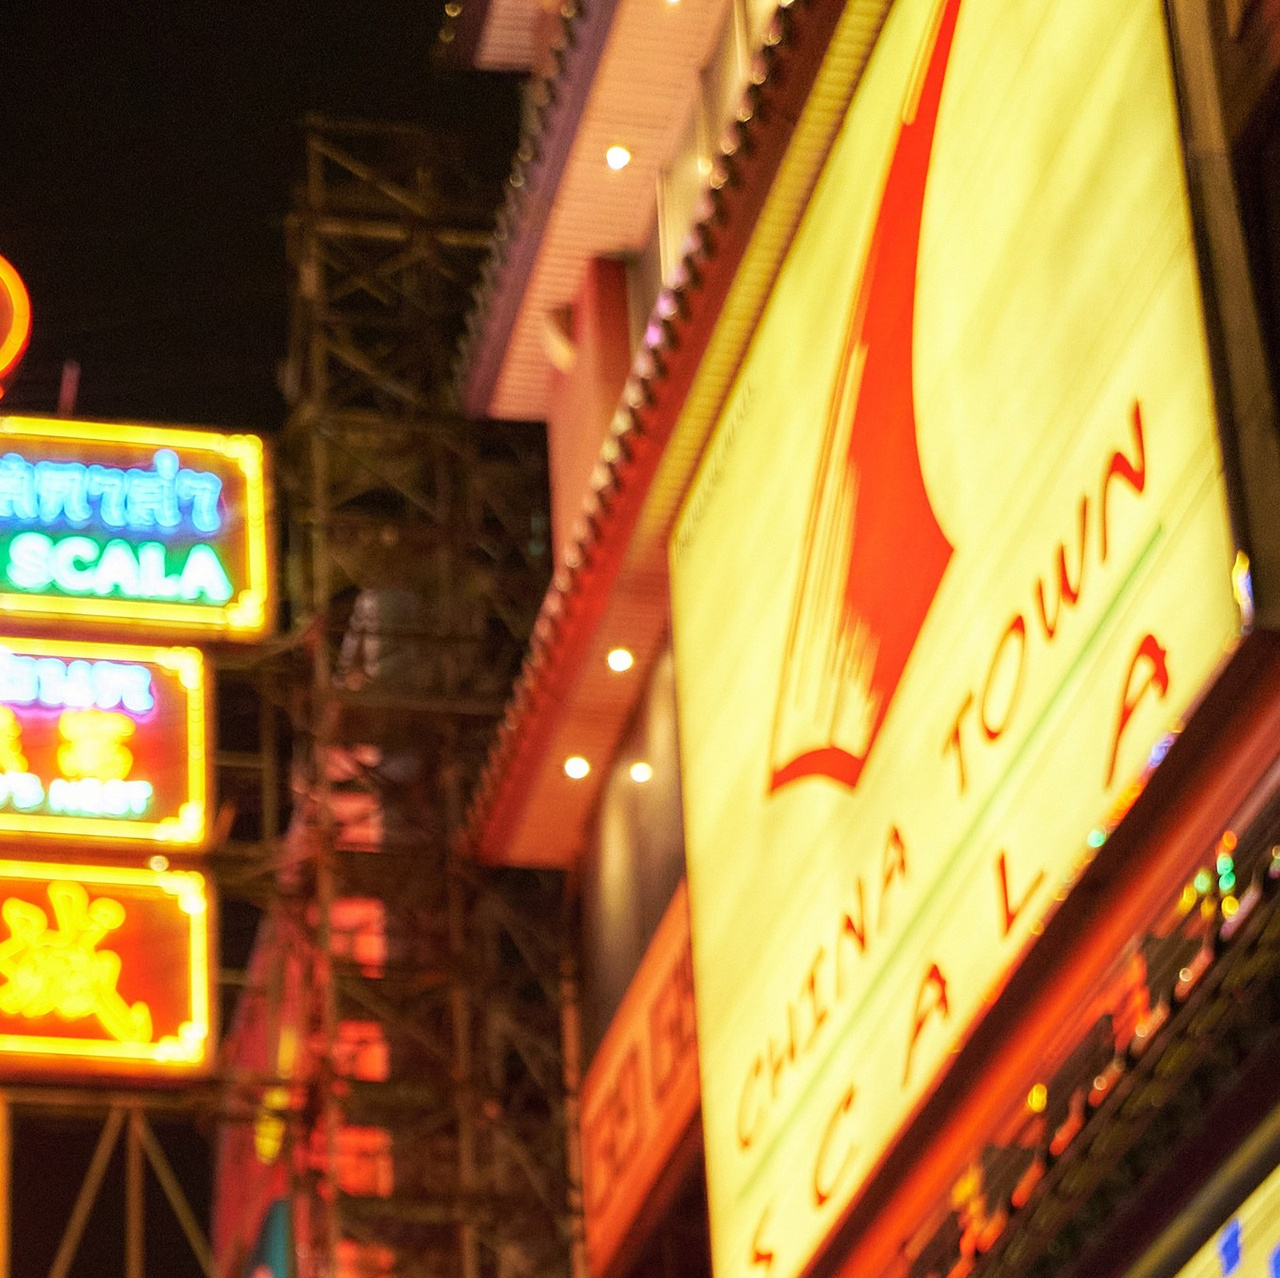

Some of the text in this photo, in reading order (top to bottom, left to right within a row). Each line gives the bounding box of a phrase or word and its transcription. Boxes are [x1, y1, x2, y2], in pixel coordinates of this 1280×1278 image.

[7, 531, 234, 602] SCALA
[738, 400, 1150, 1152] CHINA TOWN
